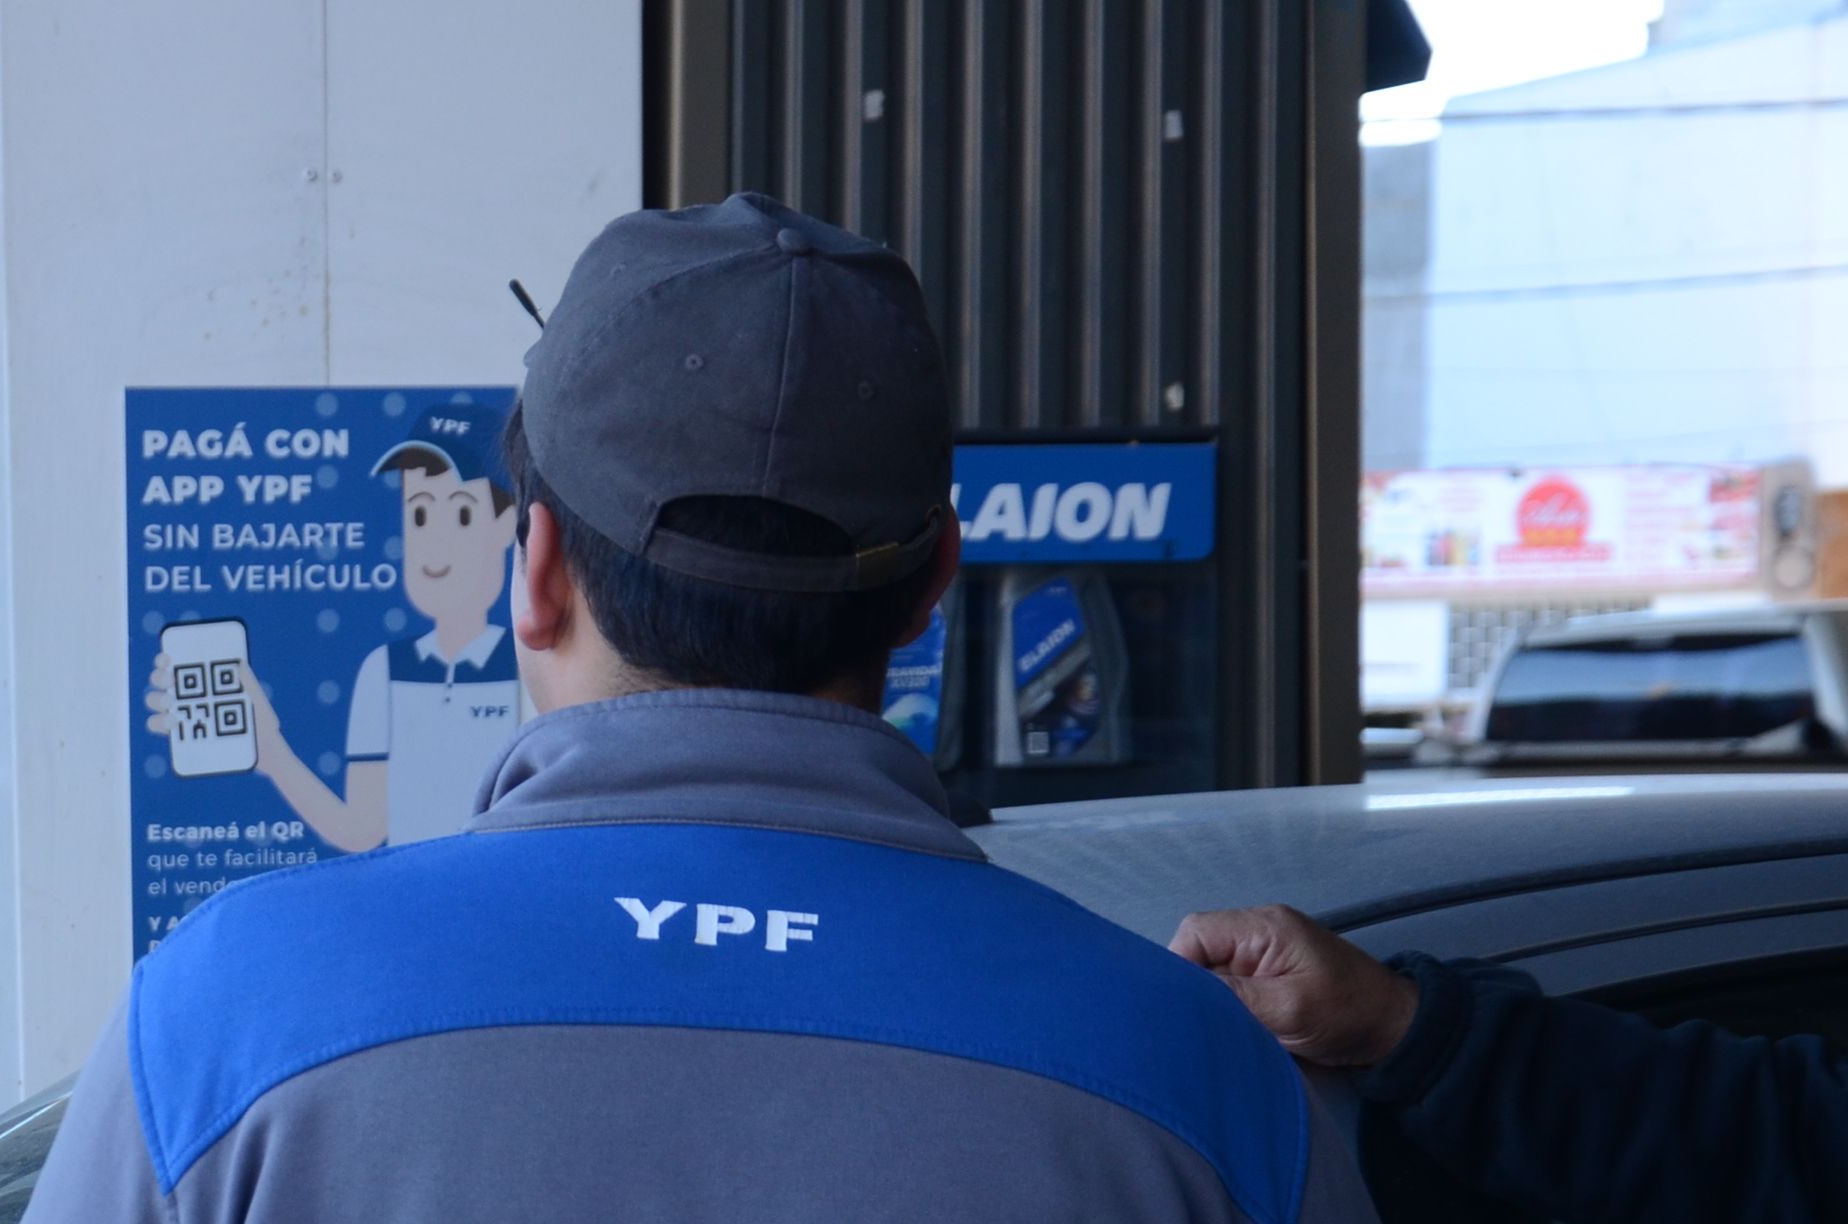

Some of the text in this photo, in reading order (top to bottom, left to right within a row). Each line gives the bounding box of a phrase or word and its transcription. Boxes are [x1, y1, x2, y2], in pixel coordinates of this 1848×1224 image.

[430, 417, 472, 435] YPF
[142, 422, 350, 459] PAGÁ CON
[142, 474, 313, 505] APP YPF
[950, 481, 1172, 543] LAION
[143, 521, 365, 550] SIN BAJARTE
[144, 558, 397, 592] DEL VEHÍCULO
[471, 705, 510, 719] YPF
[147, 821, 304, 843] Escaneá el QR
[147, 848, 318, 871] que te facilitará
[147, 877, 167, 895] el
[149, 916, 162, 931] Y
[613, 896, 819, 953] YPF
